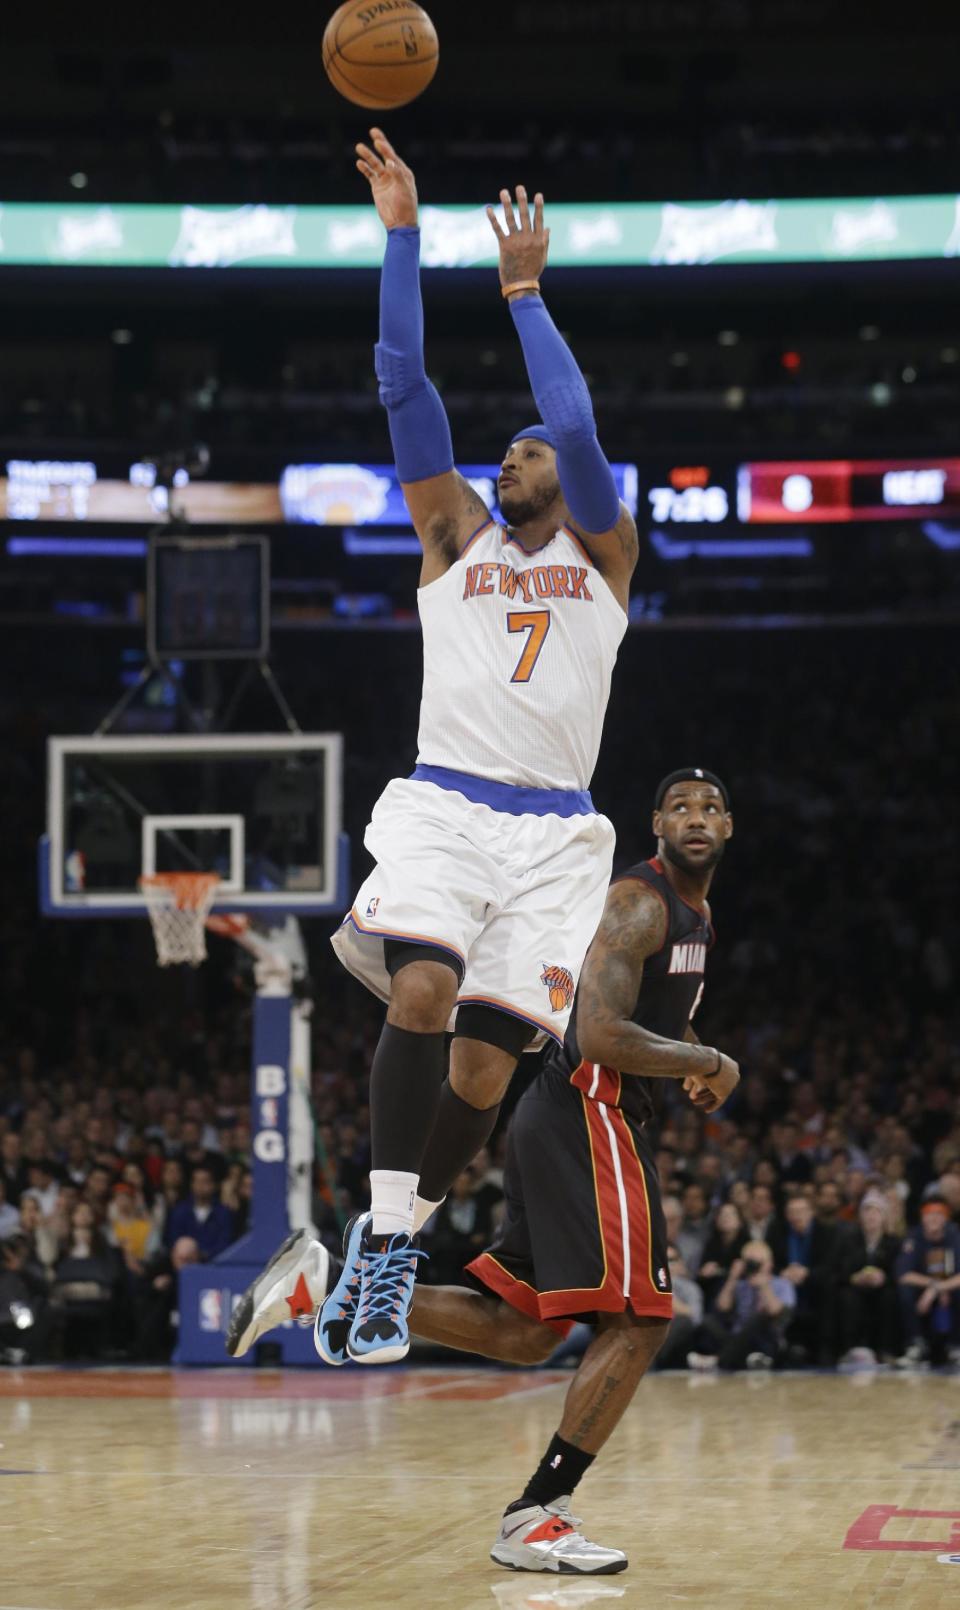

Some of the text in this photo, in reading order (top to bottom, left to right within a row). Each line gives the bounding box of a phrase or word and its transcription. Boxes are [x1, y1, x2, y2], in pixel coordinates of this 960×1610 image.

[462, 562, 594, 604] NEW YORK
[506, 609, 551, 684] 7
